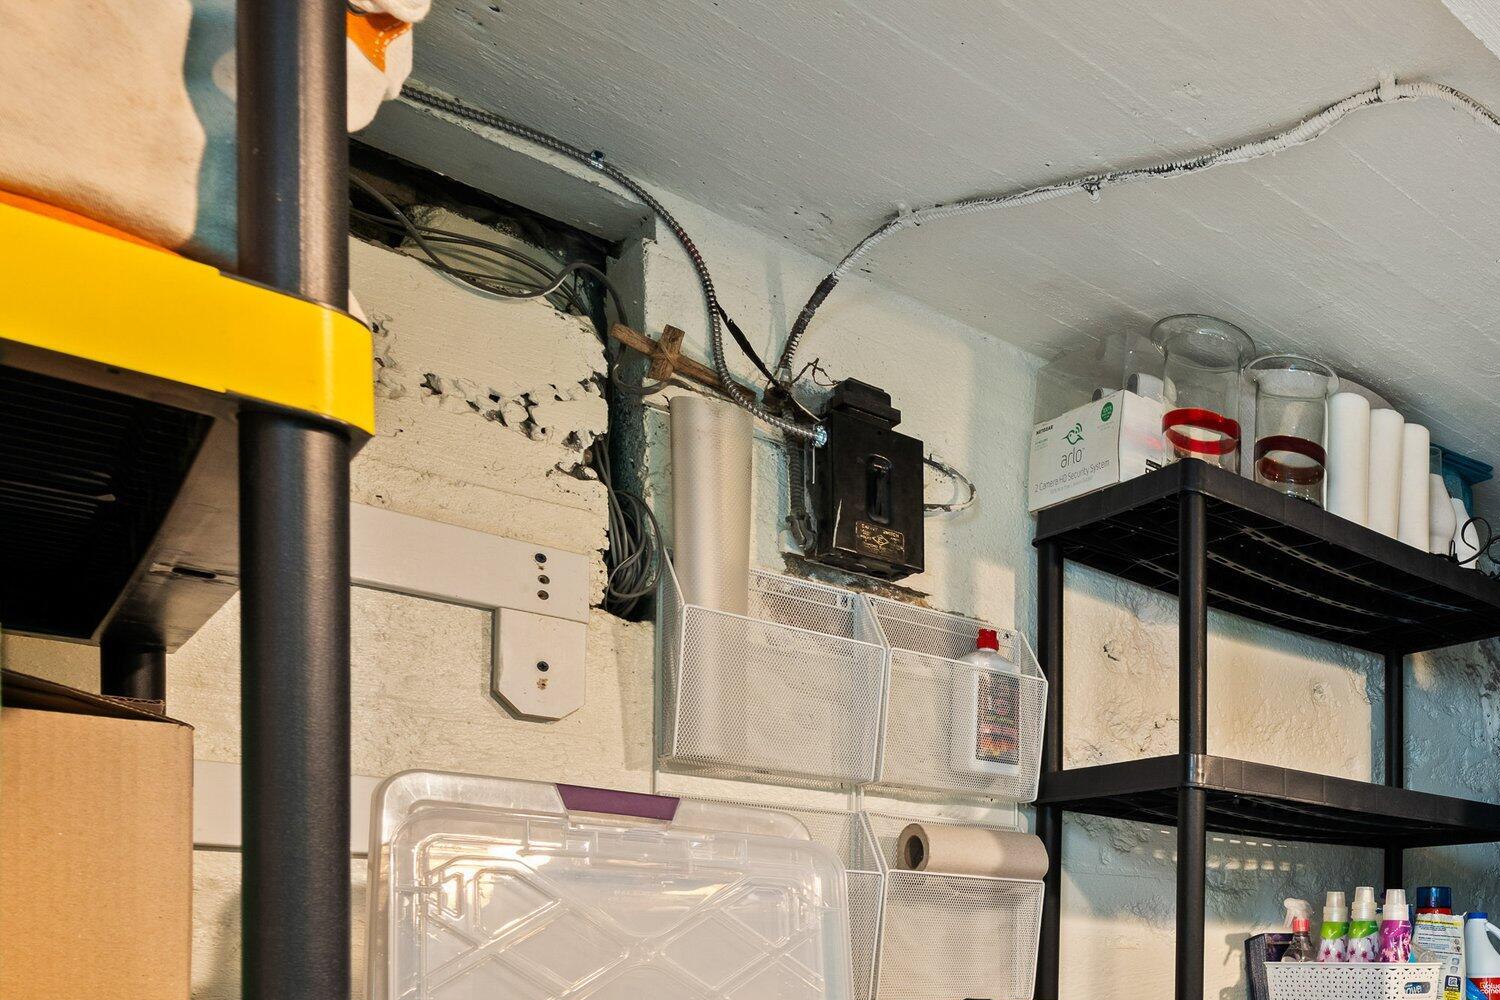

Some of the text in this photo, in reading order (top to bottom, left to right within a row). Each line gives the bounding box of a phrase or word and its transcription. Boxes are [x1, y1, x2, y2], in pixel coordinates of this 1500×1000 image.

[1060, 448, 1083, 469] arlo
[1034, 483, 1039, 493] 2
[1038, 478, 1059, 491] Camera
[1059, 472, 1067, 483] HD
[1067, 467, 1090, 481] Security
[1090, 459, 1110, 475] System
